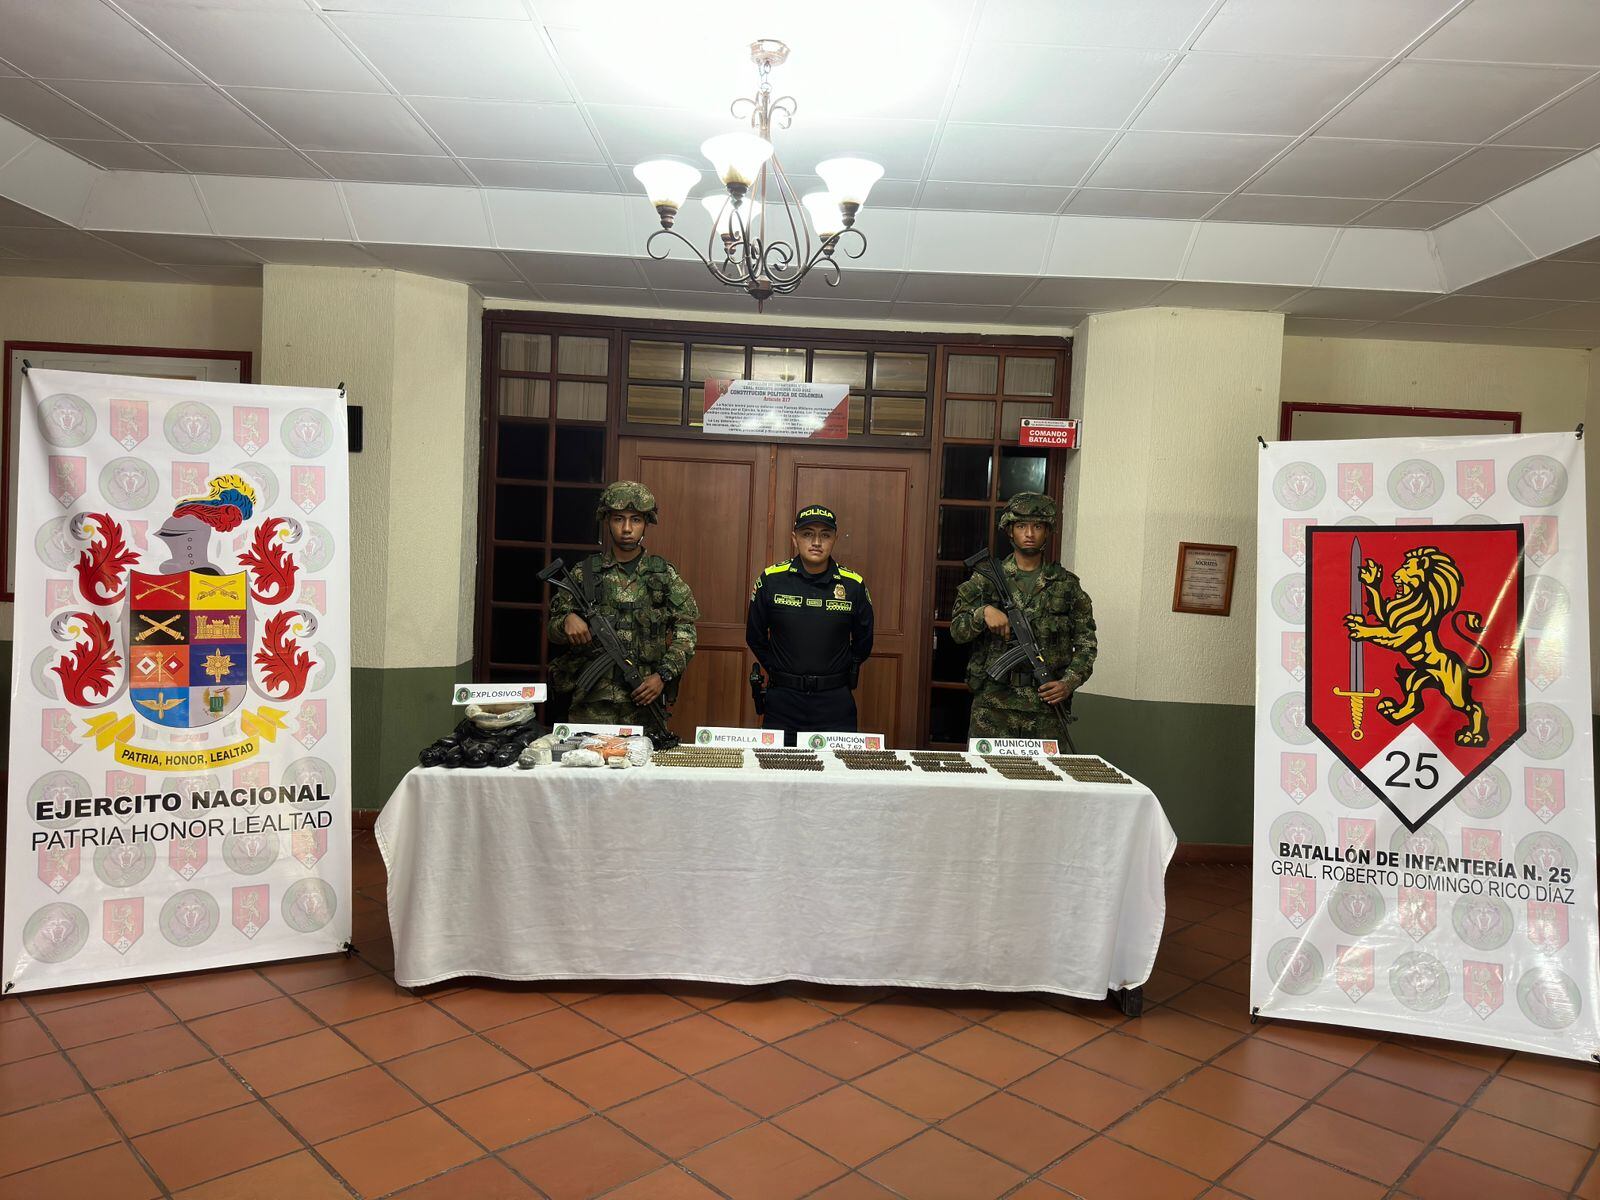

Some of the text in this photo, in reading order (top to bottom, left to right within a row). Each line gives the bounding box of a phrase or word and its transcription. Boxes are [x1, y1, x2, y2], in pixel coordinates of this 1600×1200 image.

[1029, 429, 1068, 437] COMANDO
[471, 690, 522, 699] EXPLOSIVOS
[714, 735, 757, 743] METRALLA
[826, 736, 865, 744] MUNICIÓN
[994, 738, 1041, 748] MUNICIÓN
[57, 749, 68, 758] 25
[121, 742, 254, 767] PATRIA, HONOR, LEALTAD
[1384, 750, 1440, 790] 25
[36, 783, 330, 821] EJERCITO NACIONAL
[32, 810, 333, 851] PATRIA HONOR LEALTAD
[1279, 842, 1571, 884] BATALLÓN DE INFANTERÍA N. 25
[1271, 860, 1575, 905] GRAL. ROBERTO DOMINGO RICO DÍAZ
